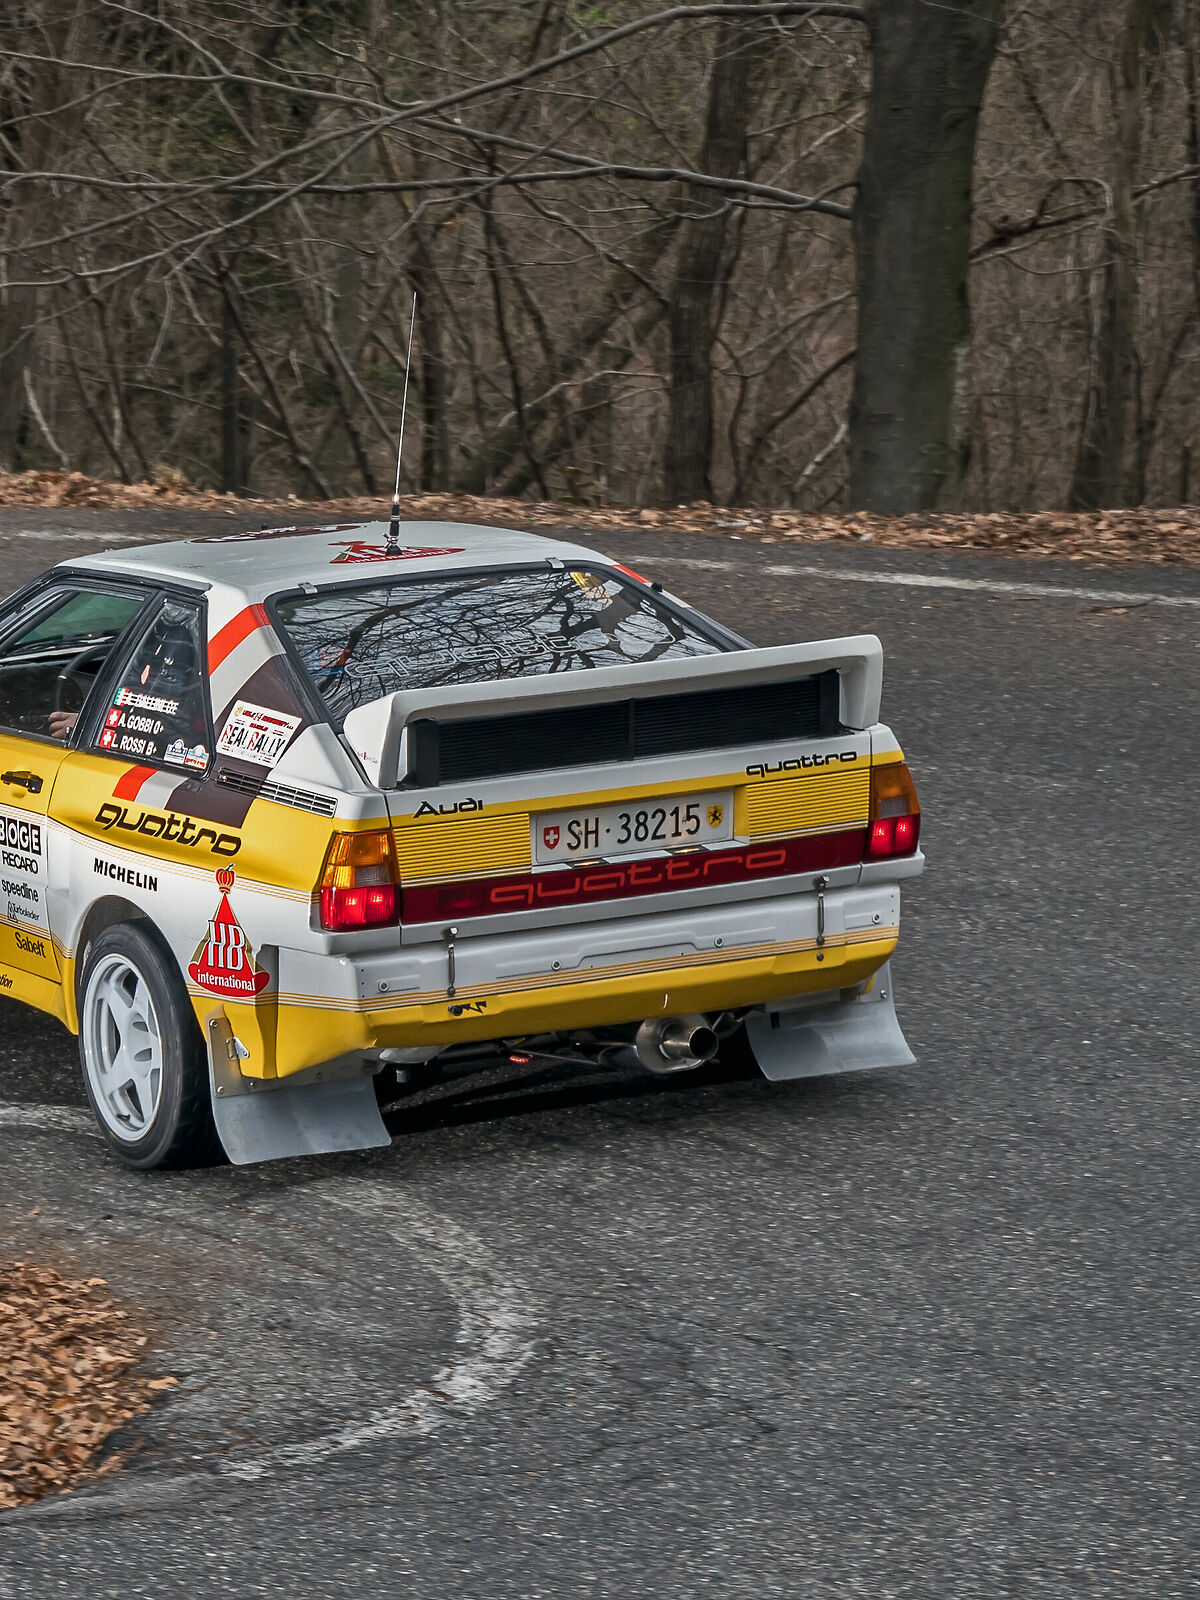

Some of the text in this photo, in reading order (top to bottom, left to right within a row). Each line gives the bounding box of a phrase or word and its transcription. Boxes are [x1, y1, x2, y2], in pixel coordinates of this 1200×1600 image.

[345, 632, 676, 679] quatt
[127, 715, 153, 733] GOBBI
[120, 736, 146, 753] ROSSI
[146, 741, 156, 755] B+
[221, 724, 285, 757] REAL RALLY
[745, 752, 857, 777] quattro
[413, 798, 483, 818] Audi
[95, 803, 241, 856] quattro
[616, 803, 700, 844] 38215
[2, 850, 38, 874] RECARO
[93, 858, 158, 892] MICHELIN
[490, 849, 786, 904] quattro
[1, 879, 39, 902] speedline
[14, 932, 46, 958] Sabelt
[207, 920, 244, 970] HB
[197, 969, 256, 991] international
